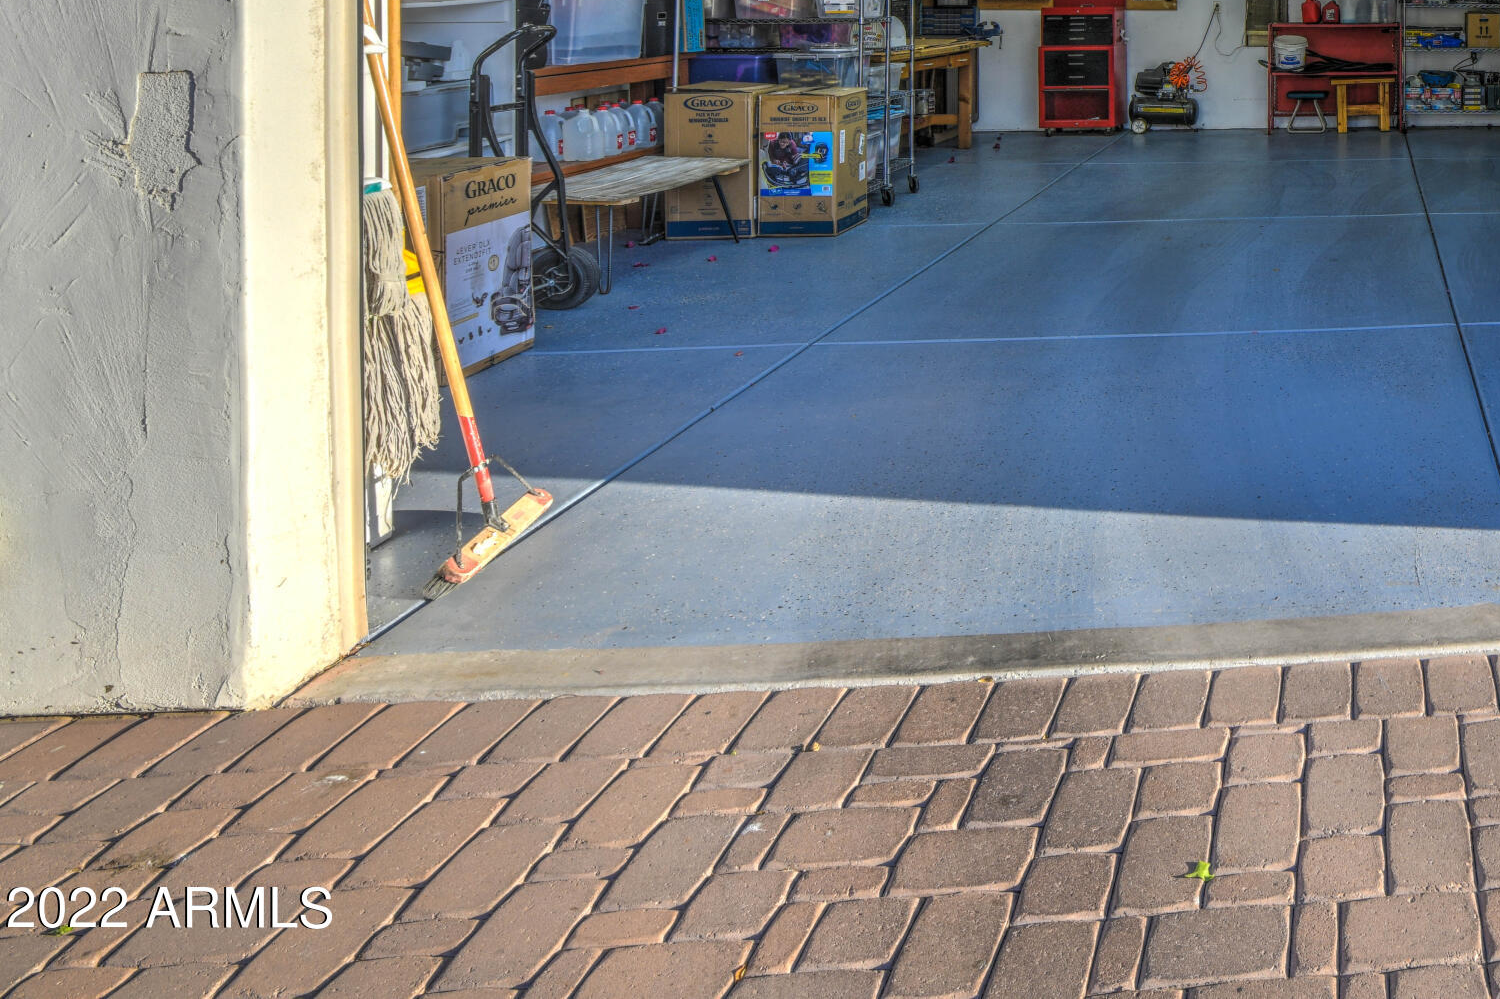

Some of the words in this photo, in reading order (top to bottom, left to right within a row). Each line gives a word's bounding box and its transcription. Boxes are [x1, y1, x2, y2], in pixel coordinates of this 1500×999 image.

[691, 98, 729, 108] GRACO
[783, 104, 815, 112] GRACO
[465, 173, 516, 199] GRACO
[463, 196, 517, 227] premier
